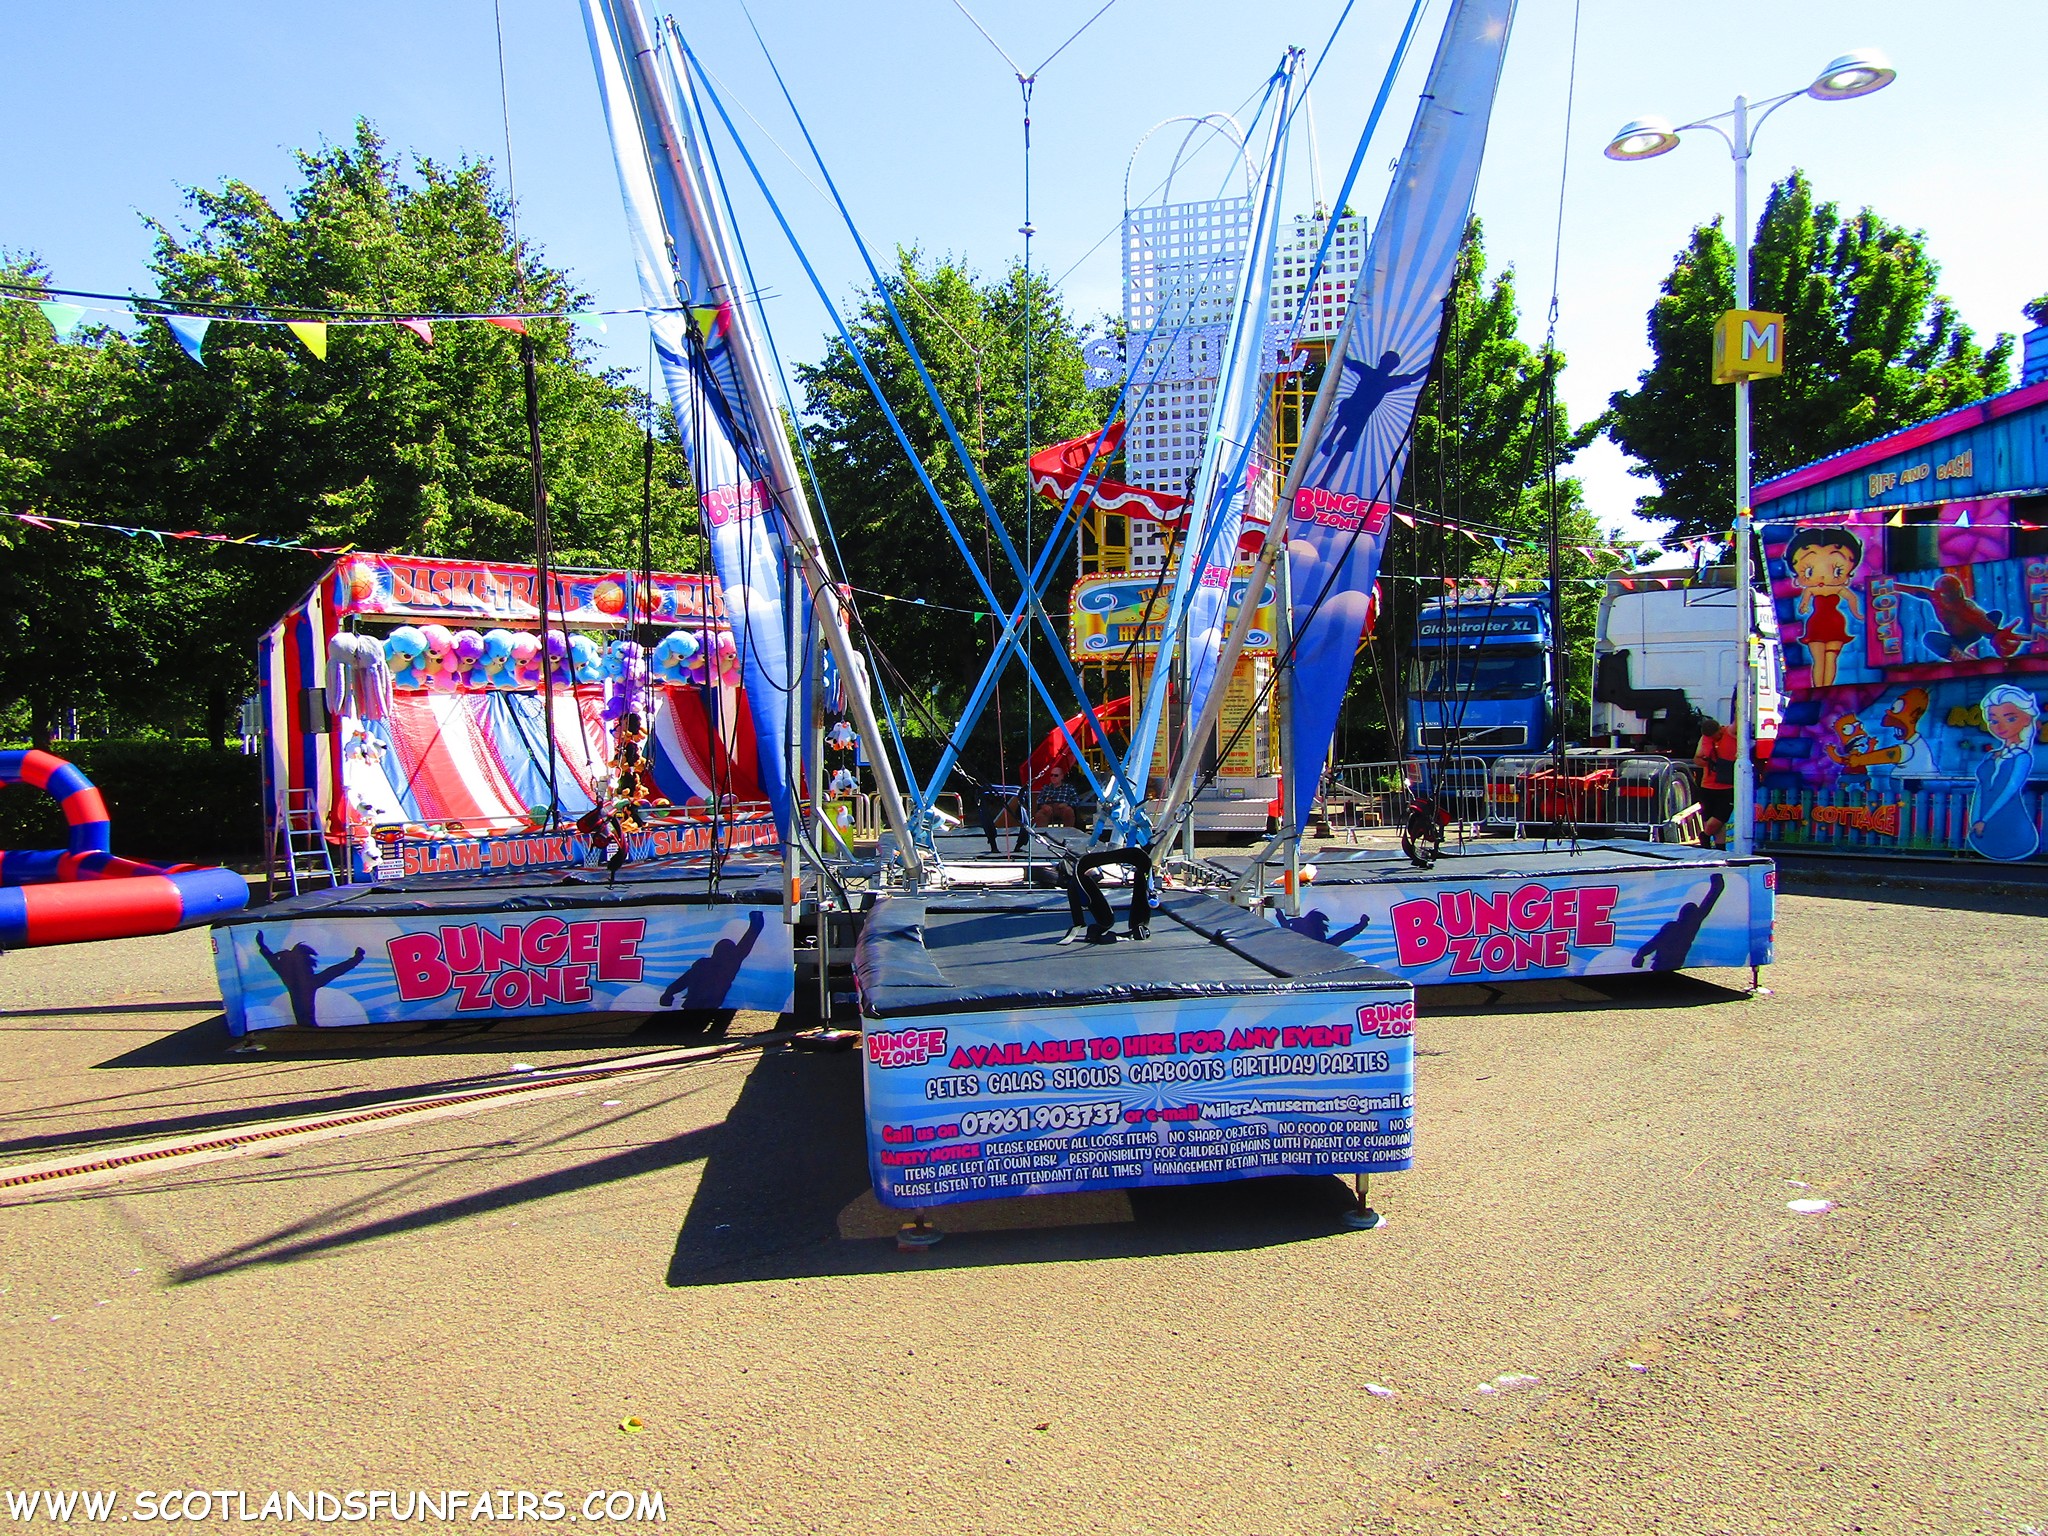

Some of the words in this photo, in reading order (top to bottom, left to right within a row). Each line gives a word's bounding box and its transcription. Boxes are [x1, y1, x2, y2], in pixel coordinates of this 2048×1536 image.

[1741, 320, 1775, 362] M
[1869, 473, 1896, 497] BIFF
[1900, 463, 1930, 485] AND
[1936, 449, 1973, 480] BASH
[1292, 486, 1392, 535] BUNGEE
[1314, 510, 1362, 532] ZONE
[392, 566, 580, 613] BASKETBALL
[1420, 621, 1509, 635] Globetrotter
[1511, 620, 1532, 632] XL
[1871, 578, 1901, 655] HOUSE
[1811, 804, 1896, 836] COTTAGE
[405, 836, 574, 876] SLAM-DUNK!
[1390, 883, 1619, 967] BUNGEE
[386, 916, 647, 1002] BUNGEE
[1447, 930, 1571, 975] ZONE
[453, 966, 593, 1012] ZONE
[1358, 1001, 1414, 1035] BUNG
[1378, 1020, 1414, 1037] ZON
[867, 1028, 947, 1063] BUNGEE
[880, 1048, 928, 1068] ZONE
[949, 1039, 1087, 1069] AVAILABLE
[1088, 1035, 1121, 1060] TO
[1123, 1033, 1176, 1057] HIRE
[1179, 1031, 1225, 1054] FOR
[1228, 1026, 1280, 1050] ANY
[1282, 1024, 1353, 1048] EVENT
[925, 1073, 979, 1099] FETES
[987, 1070, 1045, 1094] GALAS
[1052, 1065, 1121, 1089] SHOWS
[1129, 1059, 1225, 1084] CARBOOTS
[1232, 1053, 1317, 1078] BIRTHDAY
[1319, 1051, 1389, 1075] PARTIES
[880, 1148, 930, 1166] SAFETY
[930, 1142, 981, 1162] NOTICE
[986, 1139, 1024, 1156] PLEASE
[1026, 1136, 1068, 1153] REMOVE
[1070, 1134, 1089, 1149] ALL
[1090, 1132, 1126, 1148] LOOSE
[1126, 1131, 1158, 1146] ITEMS
[1169, 1129, 1186, 1144] NO
[1188, 1127, 1223, 1143] SHARP
[1225, 1123, 1268, 1140] OBJECTS
[1278, 1120, 1295, 1135] NO
[1297, 1121, 1327, 1136] FOOD
[1328, 1120, 1344, 1134] OR
[1346, 1119, 1379, 1133] DRINK
[1389, 1118, 1404, 1132] NO
[881, 1124, 914, 1144] Call
[916, 1126, 935, 1142] us
[937, 1123, 959, 1139] on
[961, 1107, 1031, 1136] 07961
[1033, 1102, 1122, 1130] 903737
[1124, 1108, 1143, 1124] or
[1146, 1103, 1199, 1123] e-mail
[894, 1180, 932, 1197] PLEASE
[934, 1178, 970, 1194] LISTEN
[971, 1176, 986, 1190] TO
[988, 1173, 1008, 1188] THE
[1010, 1168, 1073, 1185] ATTENDANT
[1074, 1167, 1090, 1181] AT
[1091, 1165, 1109, 1180] ALL
[1111, 1162, 1142, 1178] TIMES
[1153, 1158, 1224, 1175] MANAGEMENT
[1225, 1155, 1259, 1171] RETAIN
[1260, 1153, 1280, 1166] THE
[1281, 1151, 1312, 1165] RIGHT
[1314, 1150, 1330, 1164] TO
[1331, 1148, 1370, 1163] REFUSE
[905, 1166, 936, 1182] ITEMS
[938, 1164, 958, 1178] ARE
[960, 1161, 985, 1175] LEFT
[986, 1159, 1001, 1173] AT
[1003, 1156, 1031, 1171] OWN
[1033, 1153, 1058, 1168] RISK
[1069, 1146, 1152, 1165] RESPONSIBILITY
[1154, 1145, 1177, 1159] FOR
[1179, 1141, 1229, 1158] CHILDREN
[1230, 1138, 1271, 1155] REMAINS
[1273, 1136, 1301, 1150] WITH
[1303, 1135, 1343, 1151] PARENT
[1345, 1135, 1361, 1148] OR
[1362, 1131, 1412, 1147] GUARDIAN
